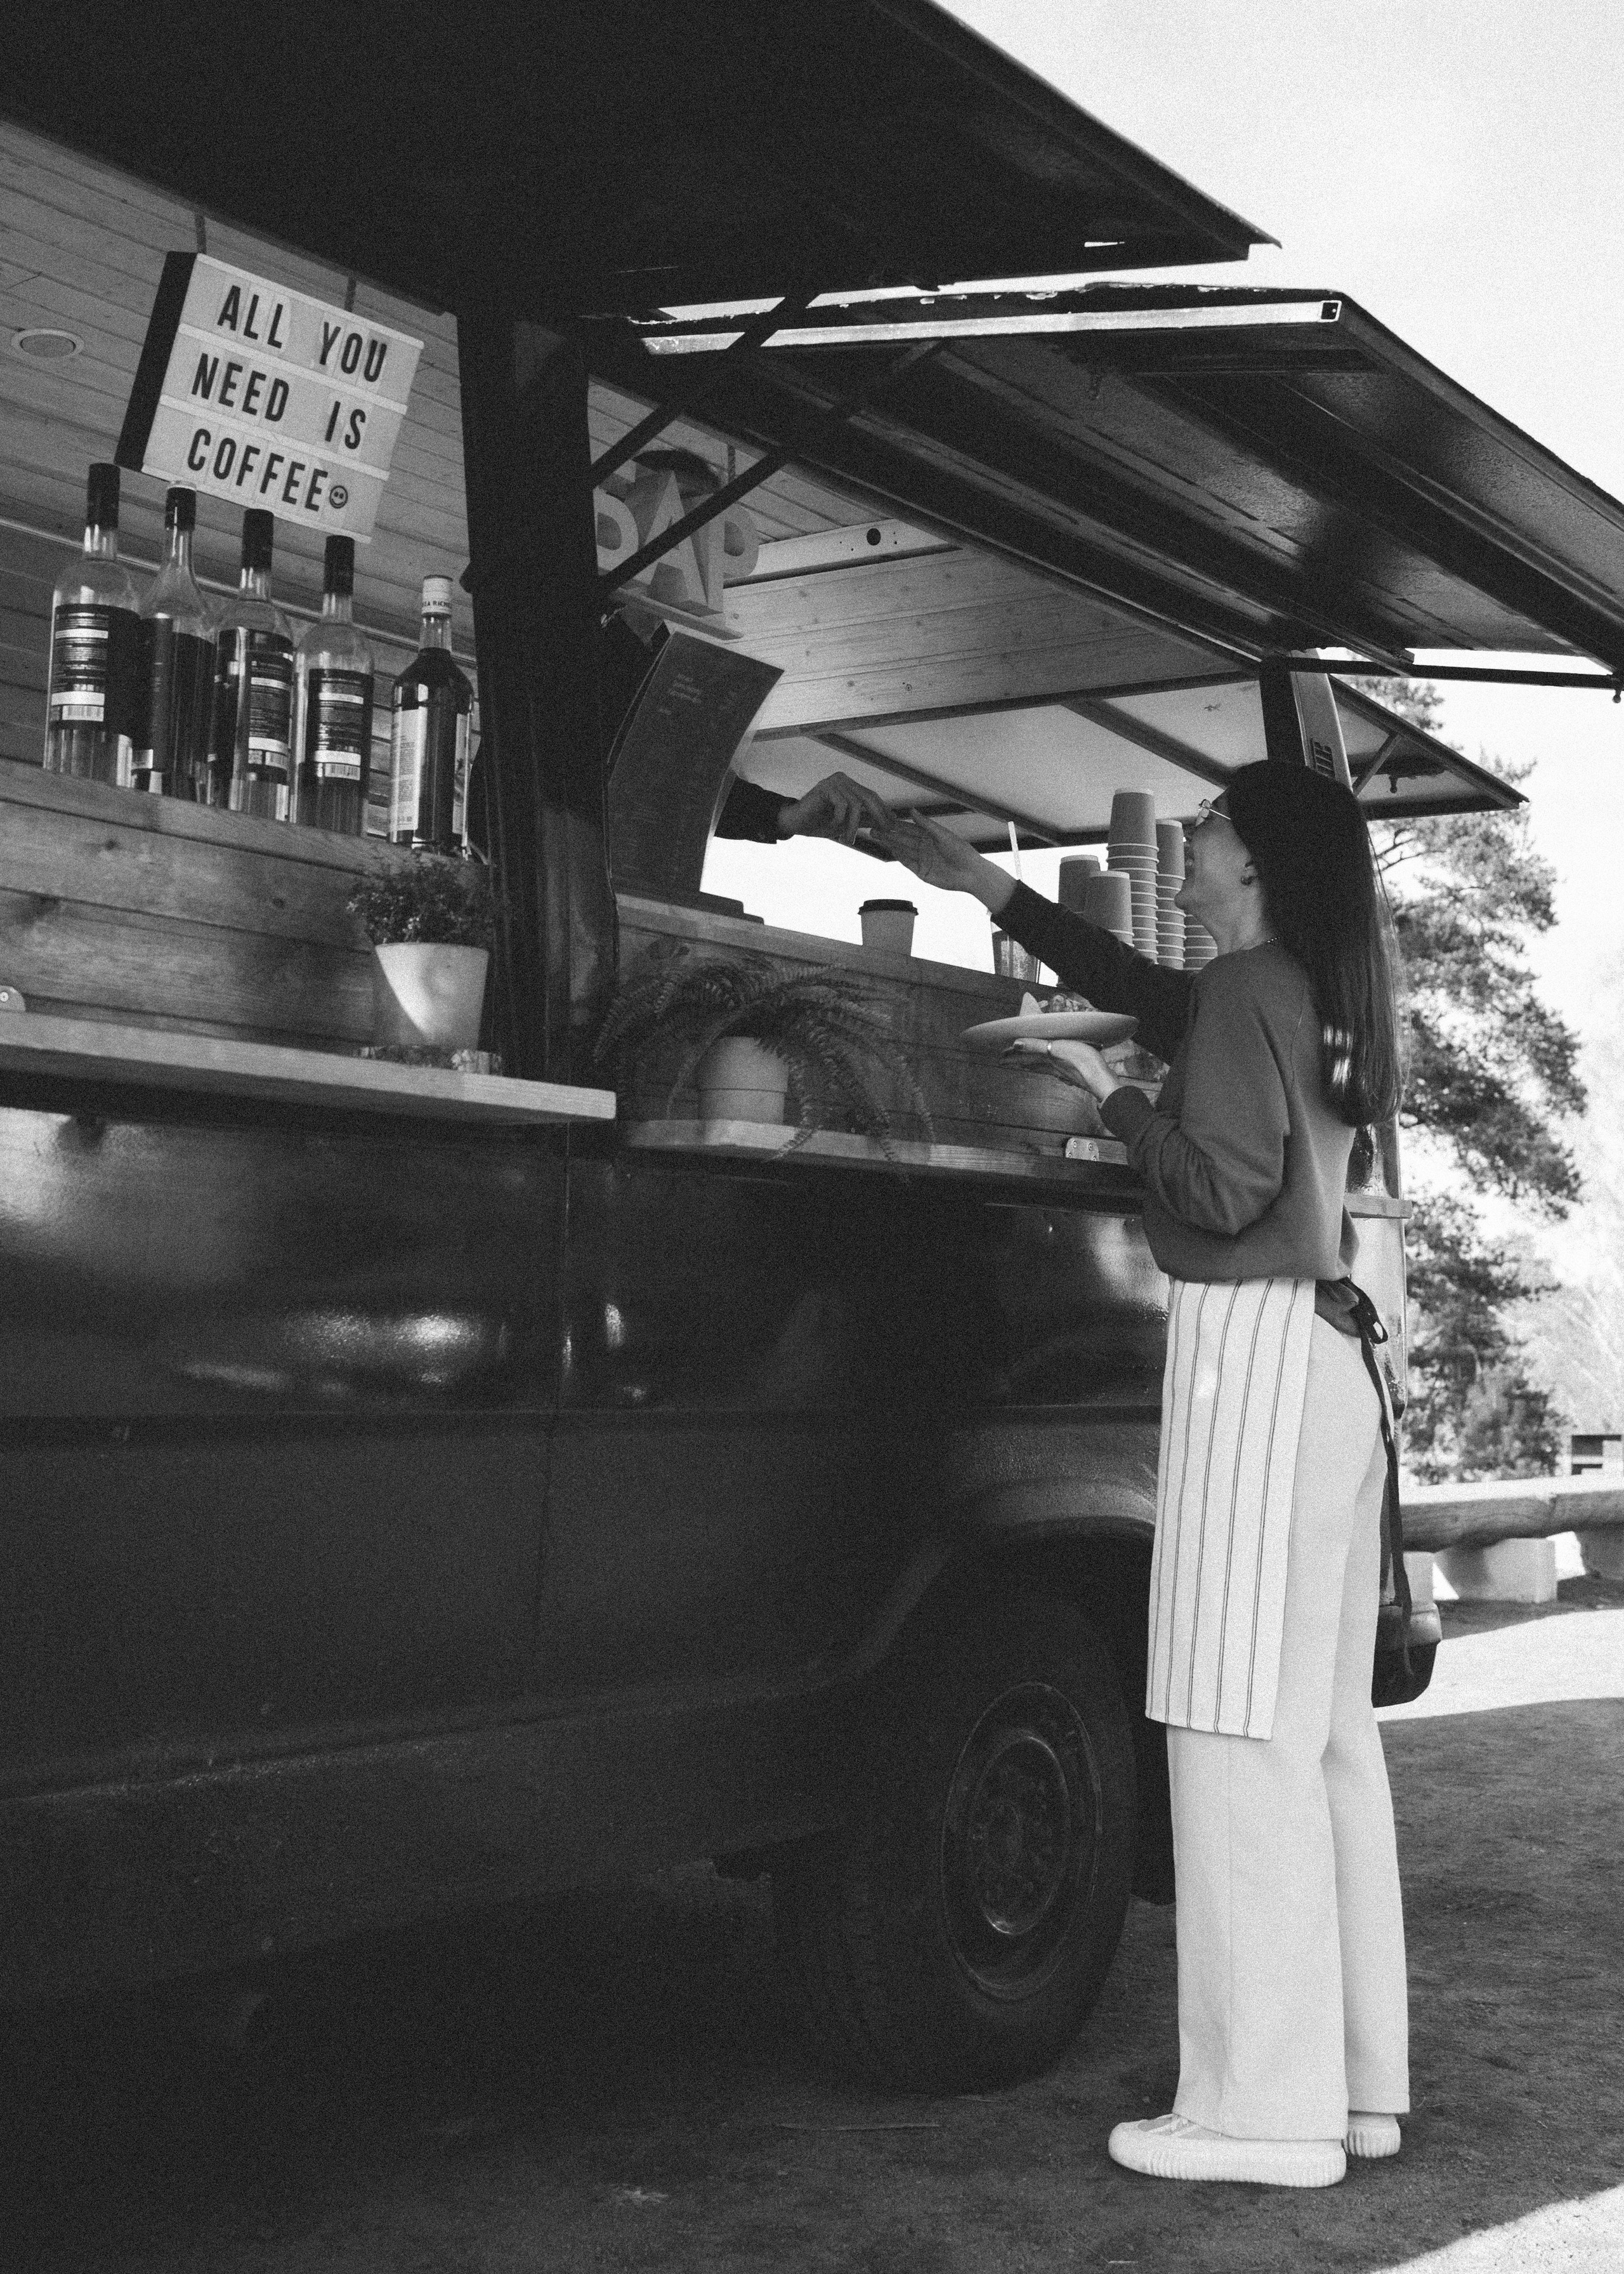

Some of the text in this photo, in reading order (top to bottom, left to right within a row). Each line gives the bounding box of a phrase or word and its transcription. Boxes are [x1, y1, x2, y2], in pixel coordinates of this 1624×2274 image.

[217, 285, 388, 383] ALL YOU
[192, 353, 366, 450] NEED IS
[188, 428, 329, 511] COFFEE
